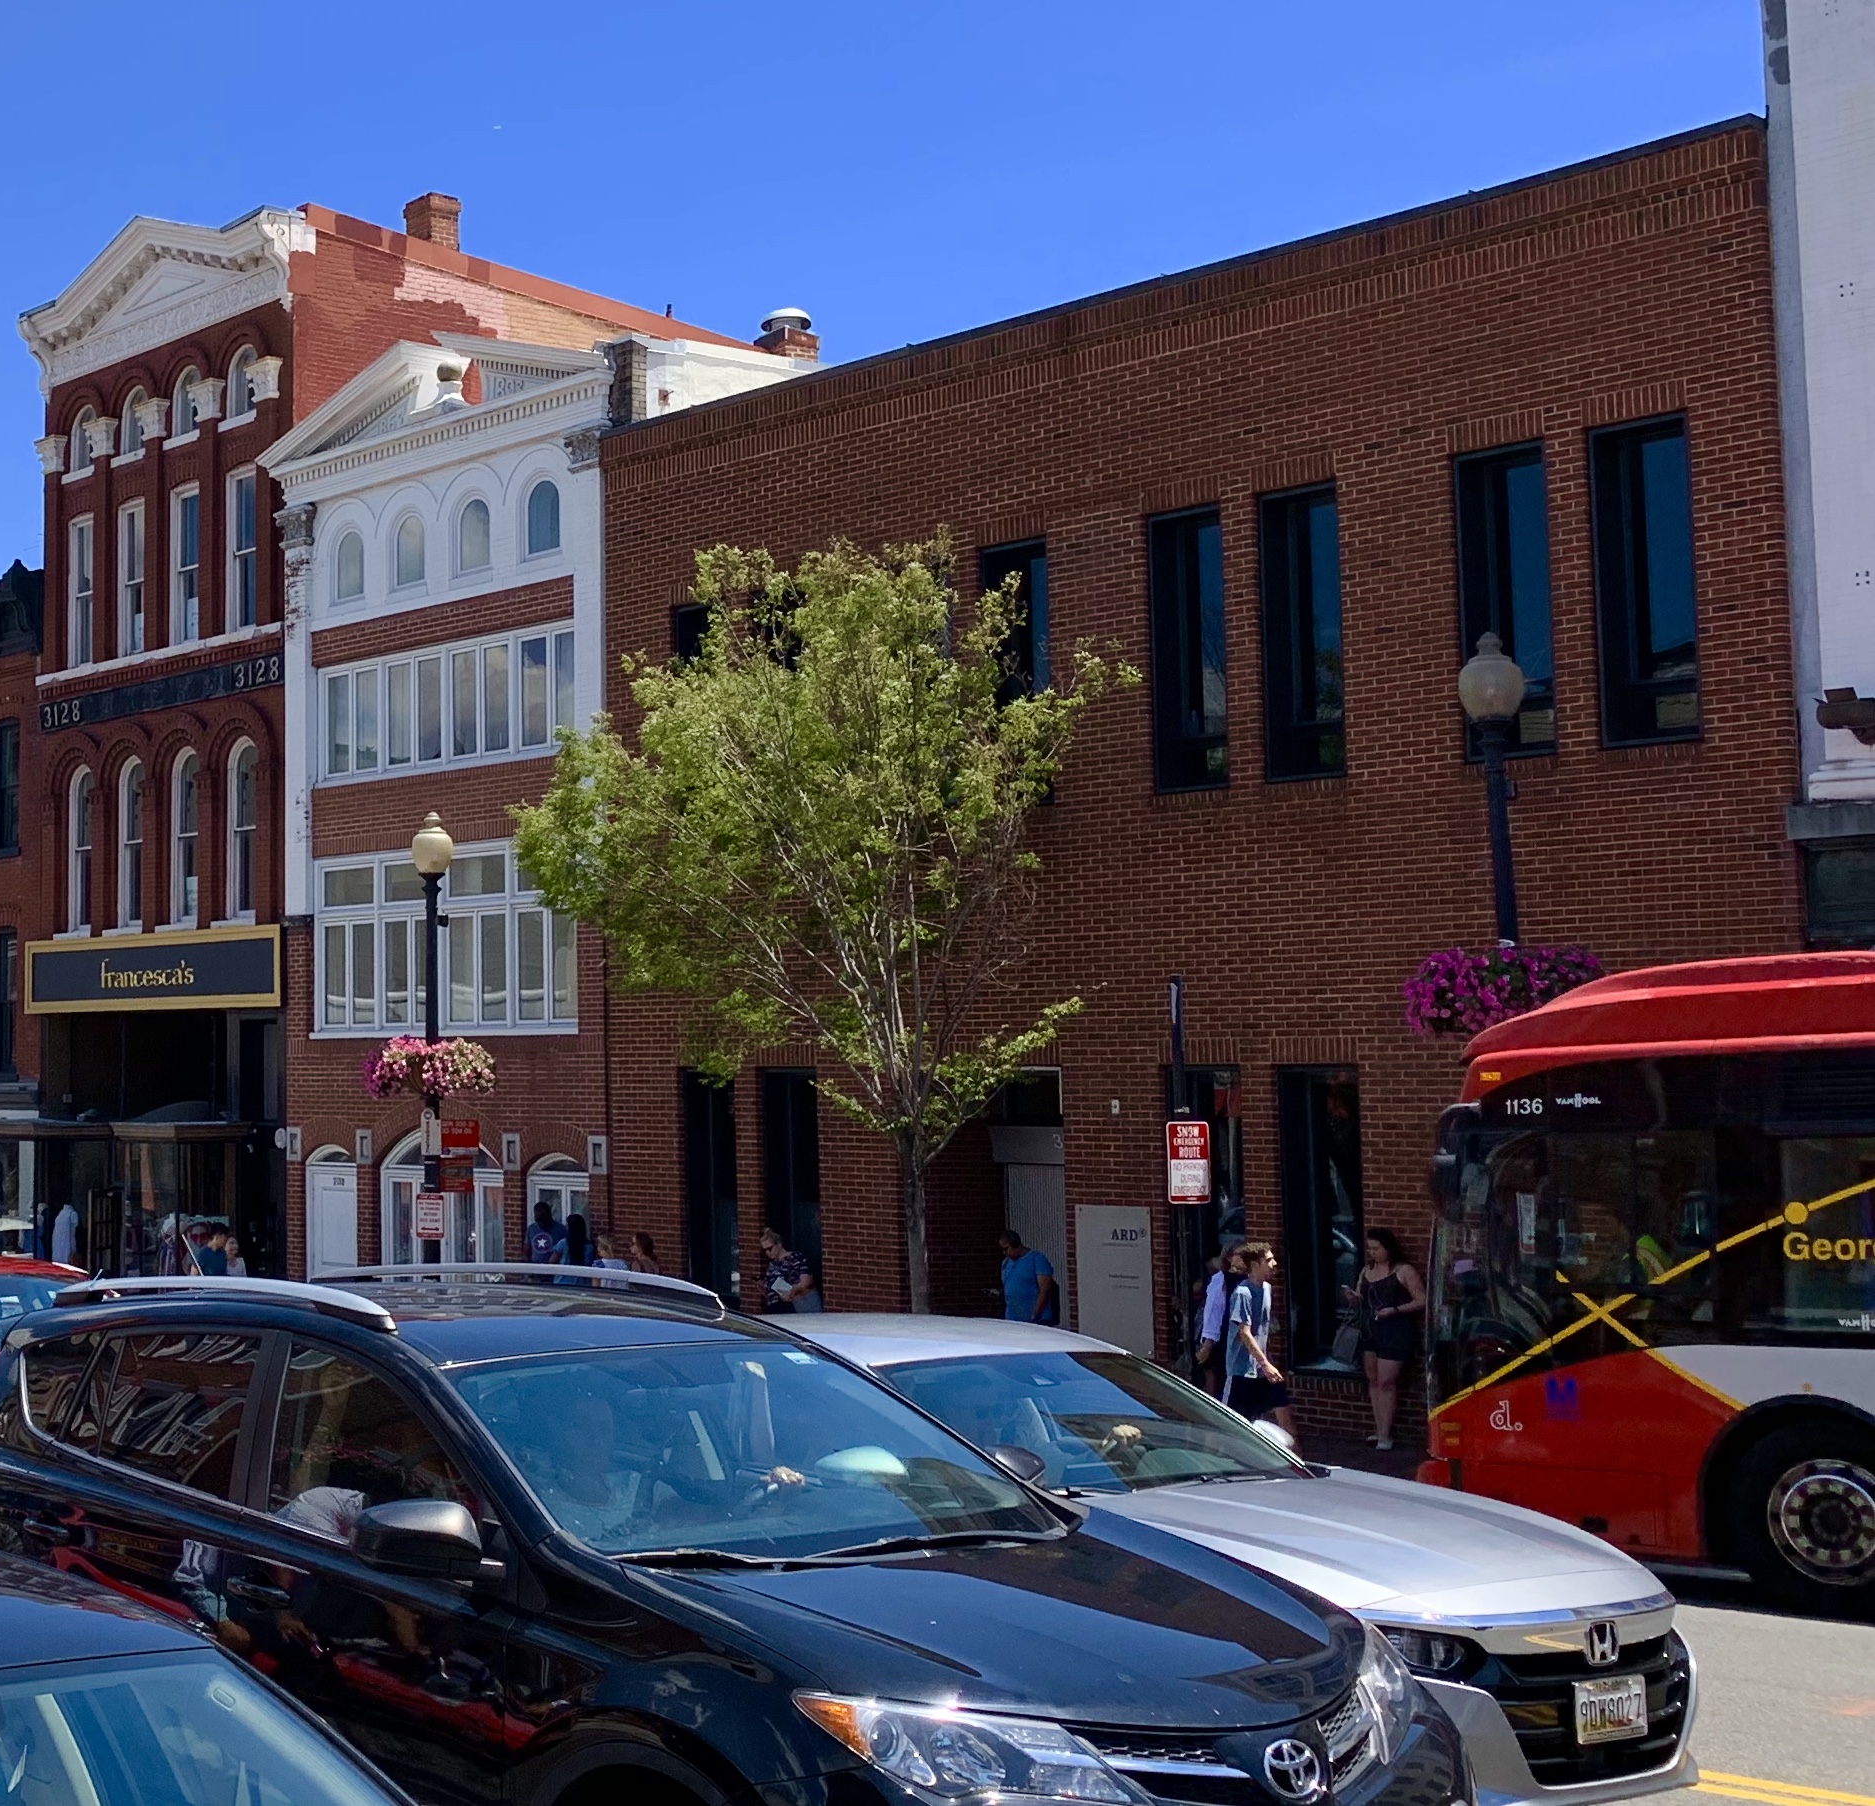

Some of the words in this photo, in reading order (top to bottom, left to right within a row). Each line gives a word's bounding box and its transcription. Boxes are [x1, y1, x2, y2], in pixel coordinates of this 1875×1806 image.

[234, 656, 280, 688] 3128
[43, 700, 81, 728] 3128
[100, 958, 194, 989] francesca's
[1505, 1098, 1543, 1115] 1136
[1176, 1126, 1199, 1137] SNOW
[1173, 1137, 1205, 1146] EMERGENCY
[1179, 1146, 1201, 1158] ROUTE
[1180, 1173, 1201, 1184] DURING
[1174, 1185, 1207, 1195] EMERGENCY
[1110, 1228, 1138, 1241] ARD
